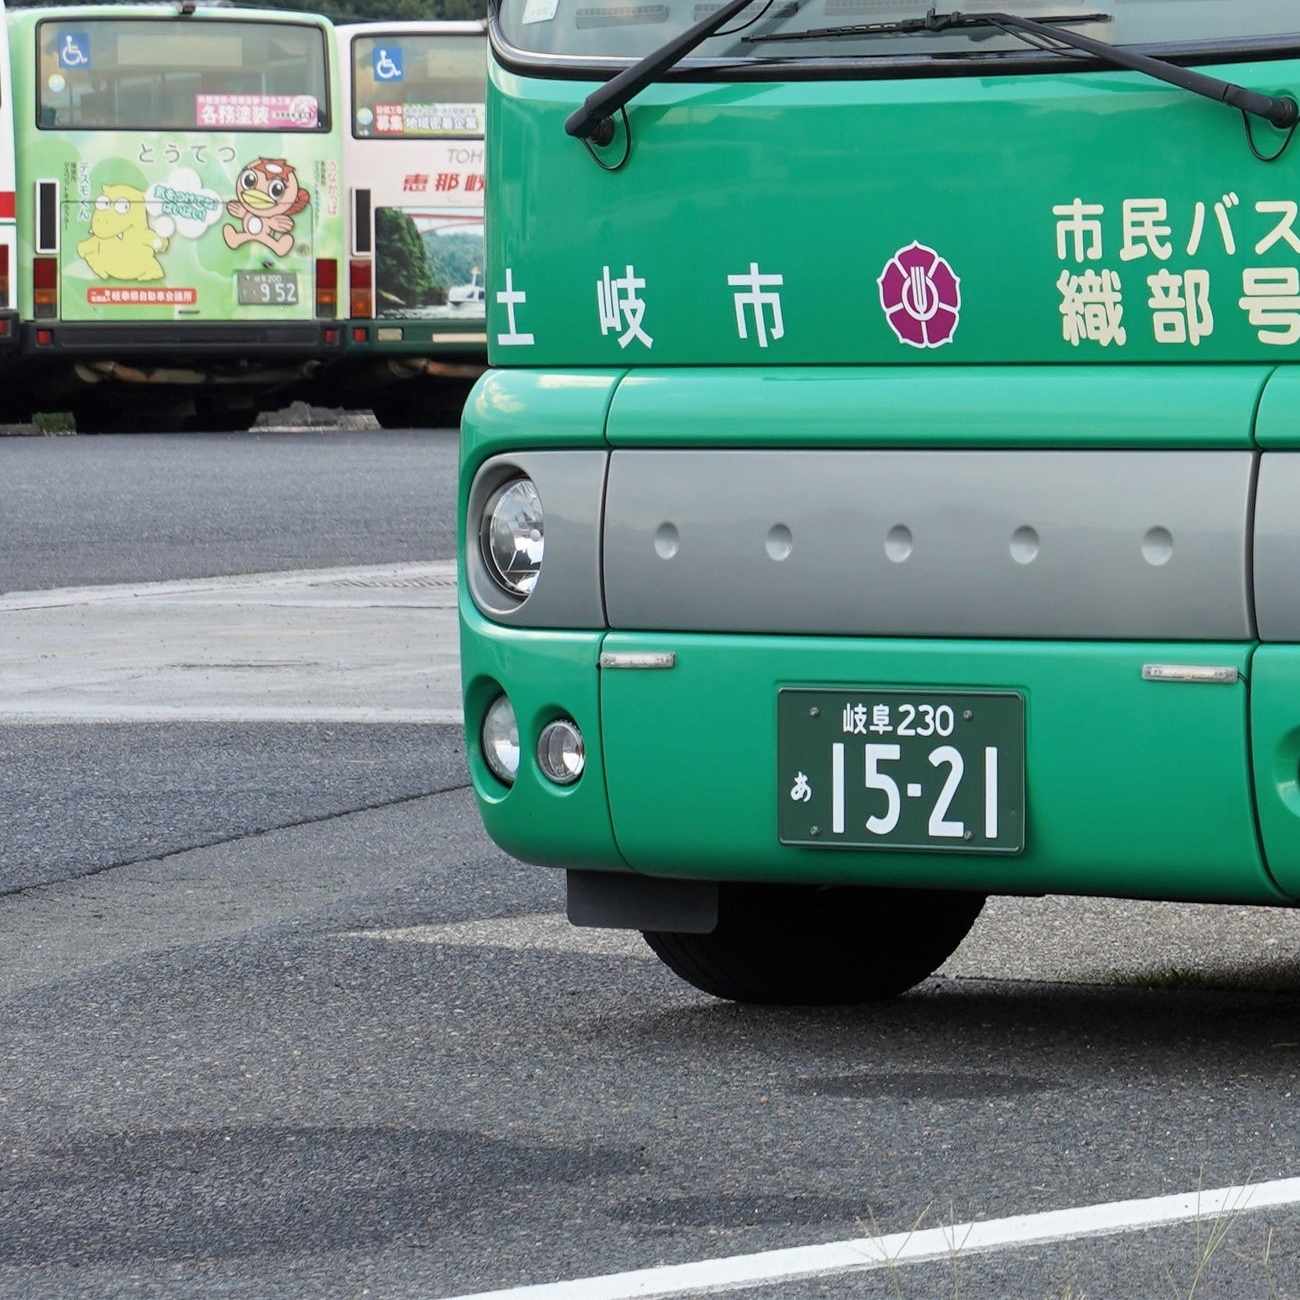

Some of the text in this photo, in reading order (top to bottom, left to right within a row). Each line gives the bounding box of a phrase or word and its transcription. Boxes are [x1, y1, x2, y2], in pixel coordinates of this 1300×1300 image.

[138, 143, 236, 164] とうてつ
[496, 262, 785, 349] 土岐市
[842, 702, 955, 737] 岐阜230
[790, 771, 812, 802] あ
[832, 743, 998, 838] 15-21
